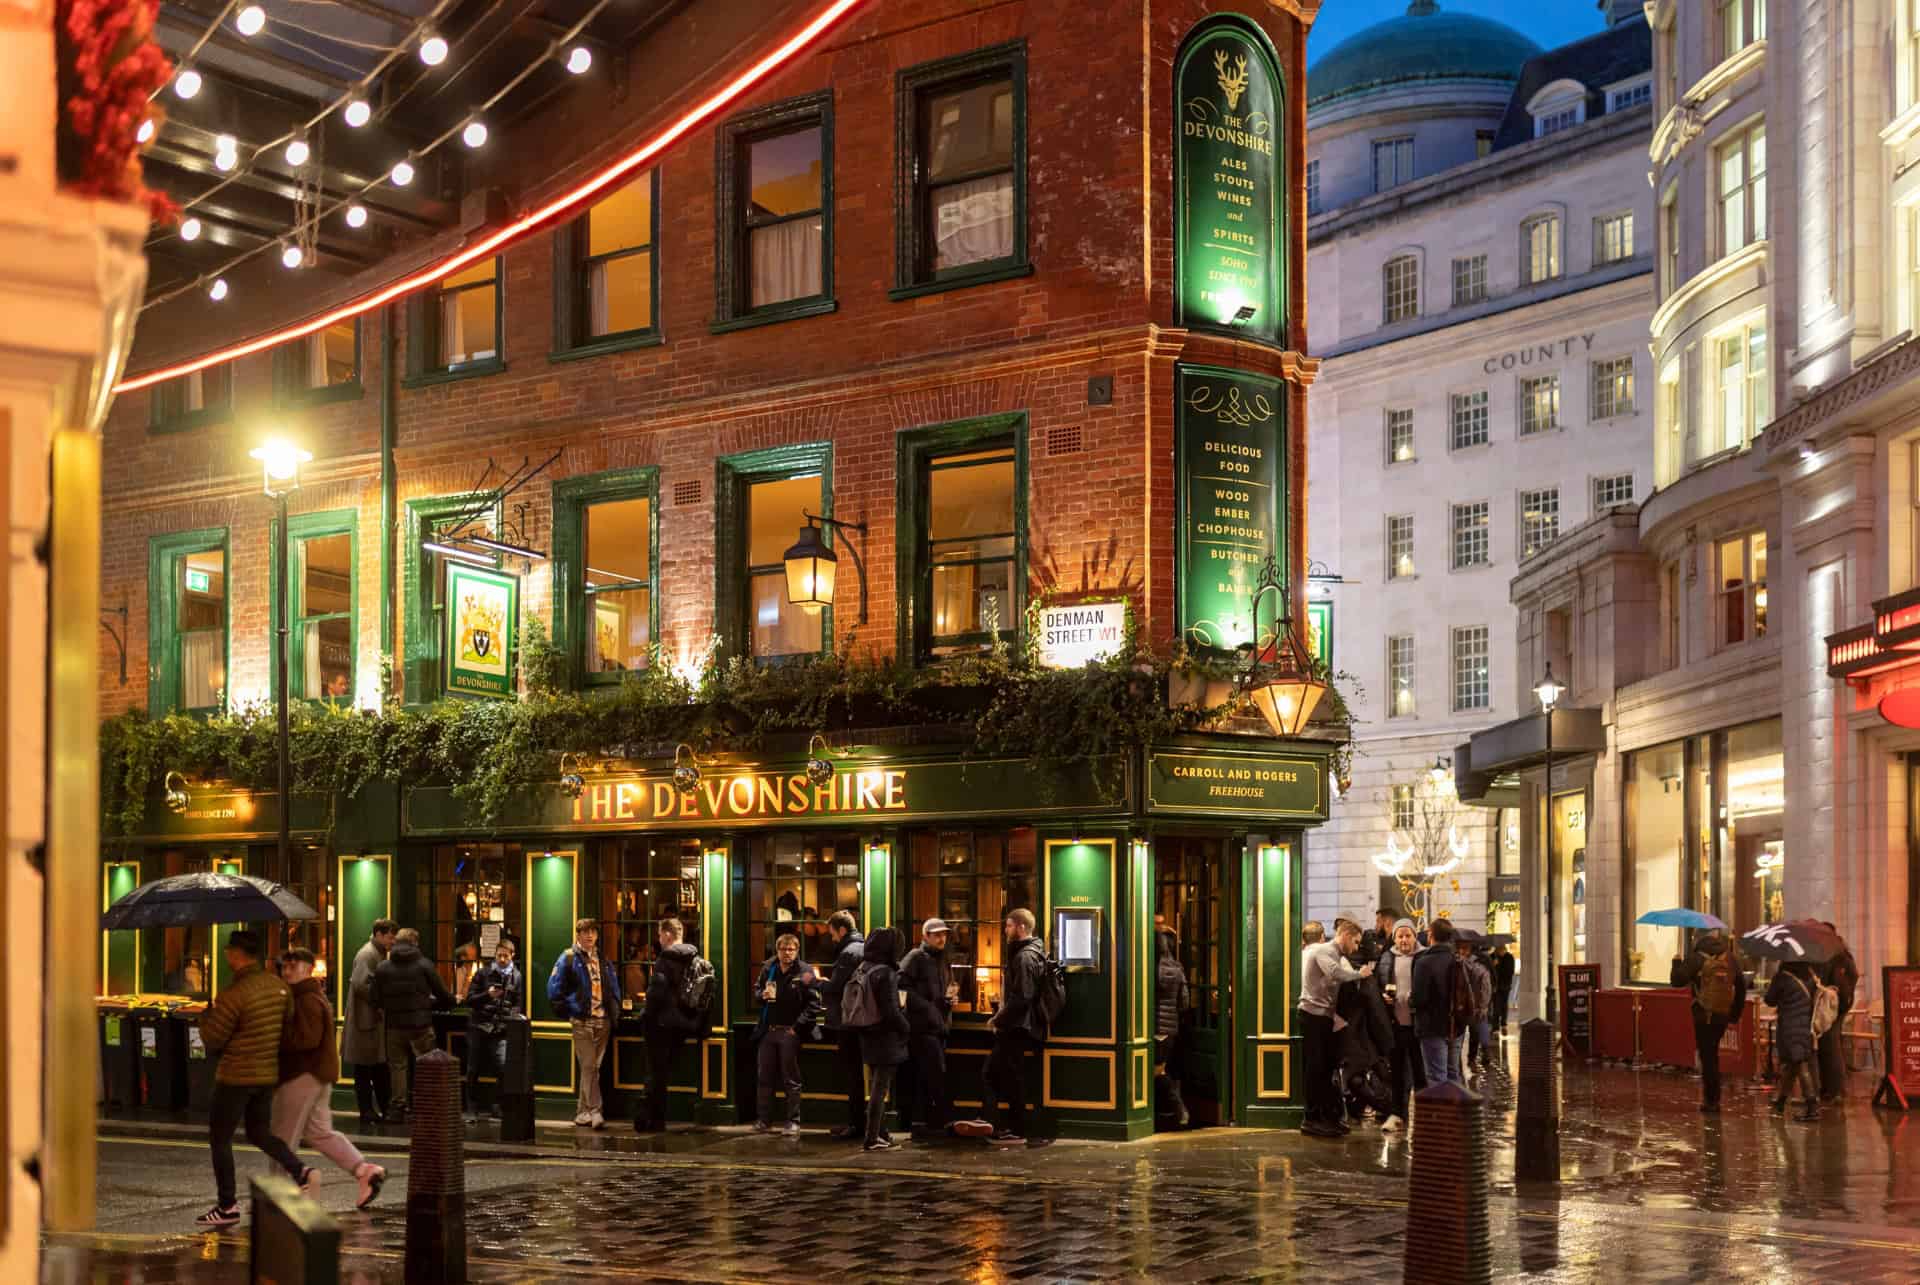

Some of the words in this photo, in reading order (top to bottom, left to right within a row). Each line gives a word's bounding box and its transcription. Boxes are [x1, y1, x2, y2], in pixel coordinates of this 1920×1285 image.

[1223, 115, 1242, 129] THE
[1184, 121, 1273, 157] DEVONSHIRE
[1221, 157, 1247, 171] ALES
[1214, 173, 1254, 190] STOUTS
[1217, 191, 1252, 207] WINES
[1227, 212, 1243, 222] and
[1213, 228, 1254, 246] SPIRITS
[1483, 332, 1595, 374] COUNTY
[1204, 442, 1262, 458] DELICIOUS
[1220, 461, 1250, 473] FOOD
[1215, 489, 1249, 502] WOOD
[1215, 507, 1251, 520] EMBER
[1197, 523, 1265, 540] CHOPHOUSE
[1211, 549, 1259, 563] BUTCHER
[1047, 610, 1104, 628] DENMAN
[1047, 628, 1092, 645] STREET
[1099, 627, 1117, 640] W1
[456, 675, 503, 690] DEVONSHIRE
[1174, 767, 1224, 779] CARROLL
[1228, 769, 1251, 780] AND
[1255, 770, 1297, 782] ROGERS
[573, 783, 634, 821] THE
[652, 771, 906, 817] DEVONSHIRE
[1209, 785, 1265, 798] FREEHOUSE
[1071, 895, 1089, 903] MENU
